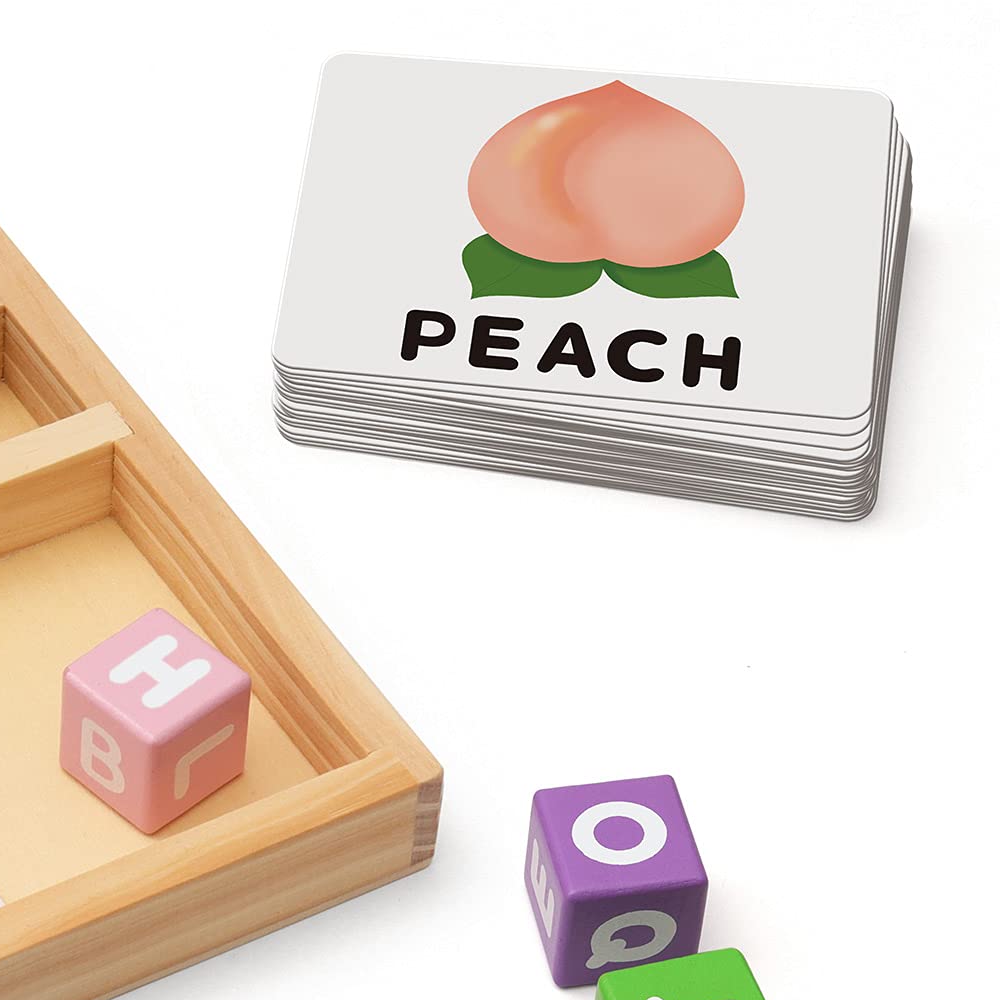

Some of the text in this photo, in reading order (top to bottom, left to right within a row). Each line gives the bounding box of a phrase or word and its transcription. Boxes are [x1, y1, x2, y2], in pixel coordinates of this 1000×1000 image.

[400, 309, 742, 391] PEACH
[109, 634, 211, 709] H
[80, 717, 125, 794] B
[571, 801, 668, 866] O
[530, 838, 555, 938] E
[585, 909, 677, 969] Q
